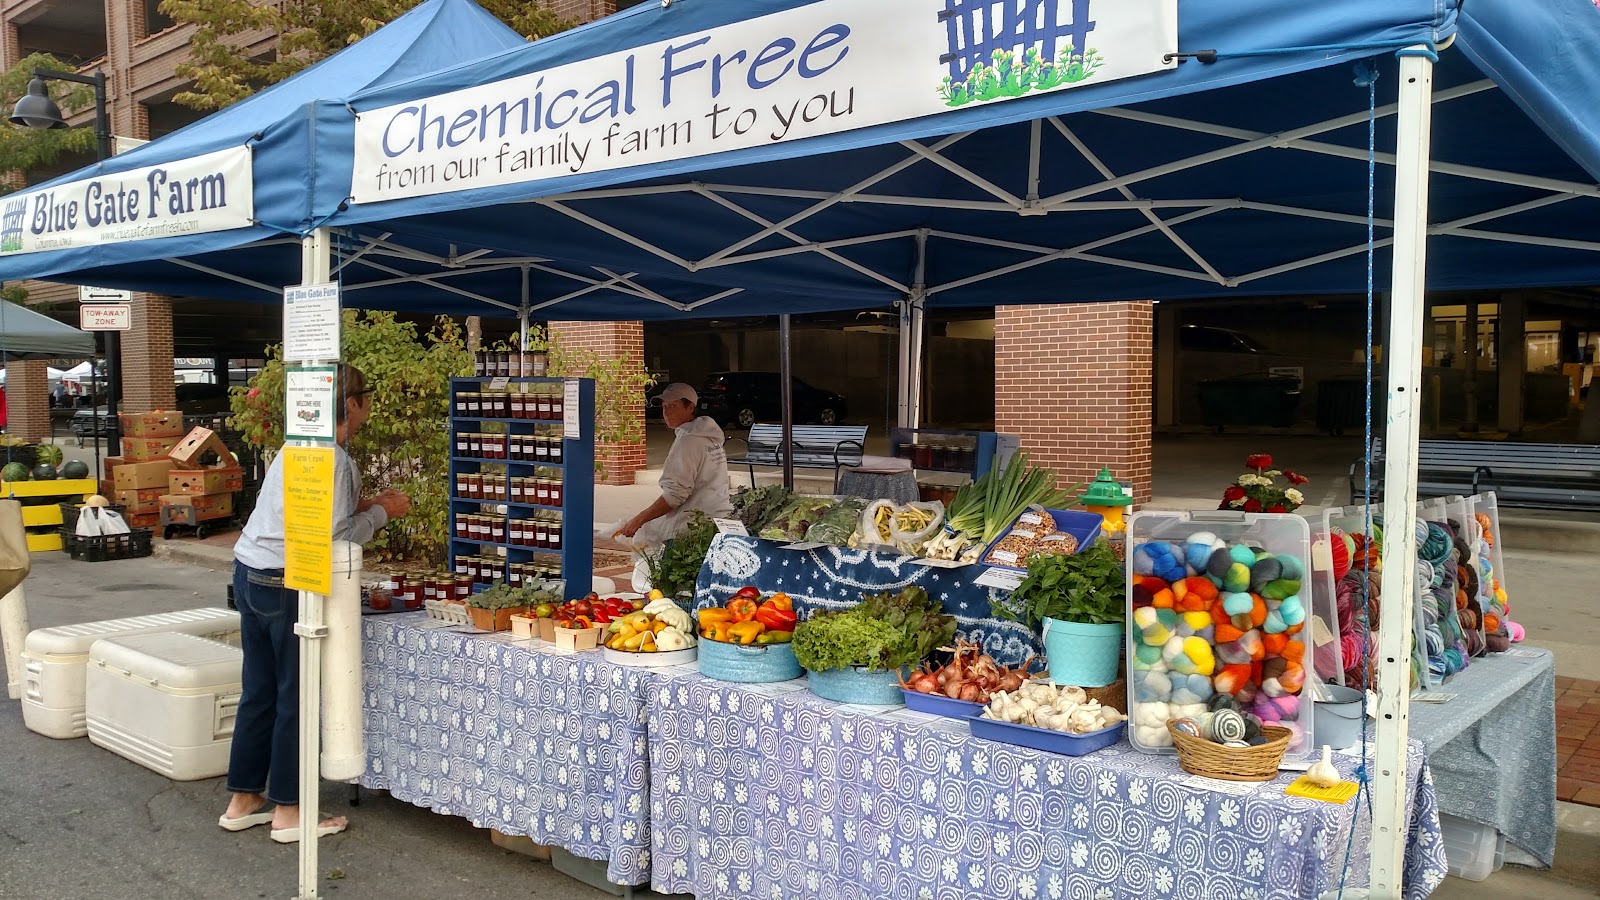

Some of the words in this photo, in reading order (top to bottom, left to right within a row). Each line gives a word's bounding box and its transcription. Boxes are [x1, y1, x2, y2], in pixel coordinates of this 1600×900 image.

[382, 55, 636, 158] Chemical
[659, 23, 851, 109] Free
[376, 163, 434, 191] from
[443, 156, 487, 182] our
[495, 133, 592, 173] family
[602, 122, 692, 157] farm
[705, 103, 757, 140] to
[770, 87, 854, 141] you
[31, 191, 78, 235] Blue
[85, 181, 140, 228] Gate
[147, 168, 227, 219] Farm
[295, 290, 307, 299] Blue
[308, 288, 323, 298] Gate
[323, 287, 337, 297] Farm
[293, 453, 307, 462] Farm
[308, 454, 324, 462] Crawl
